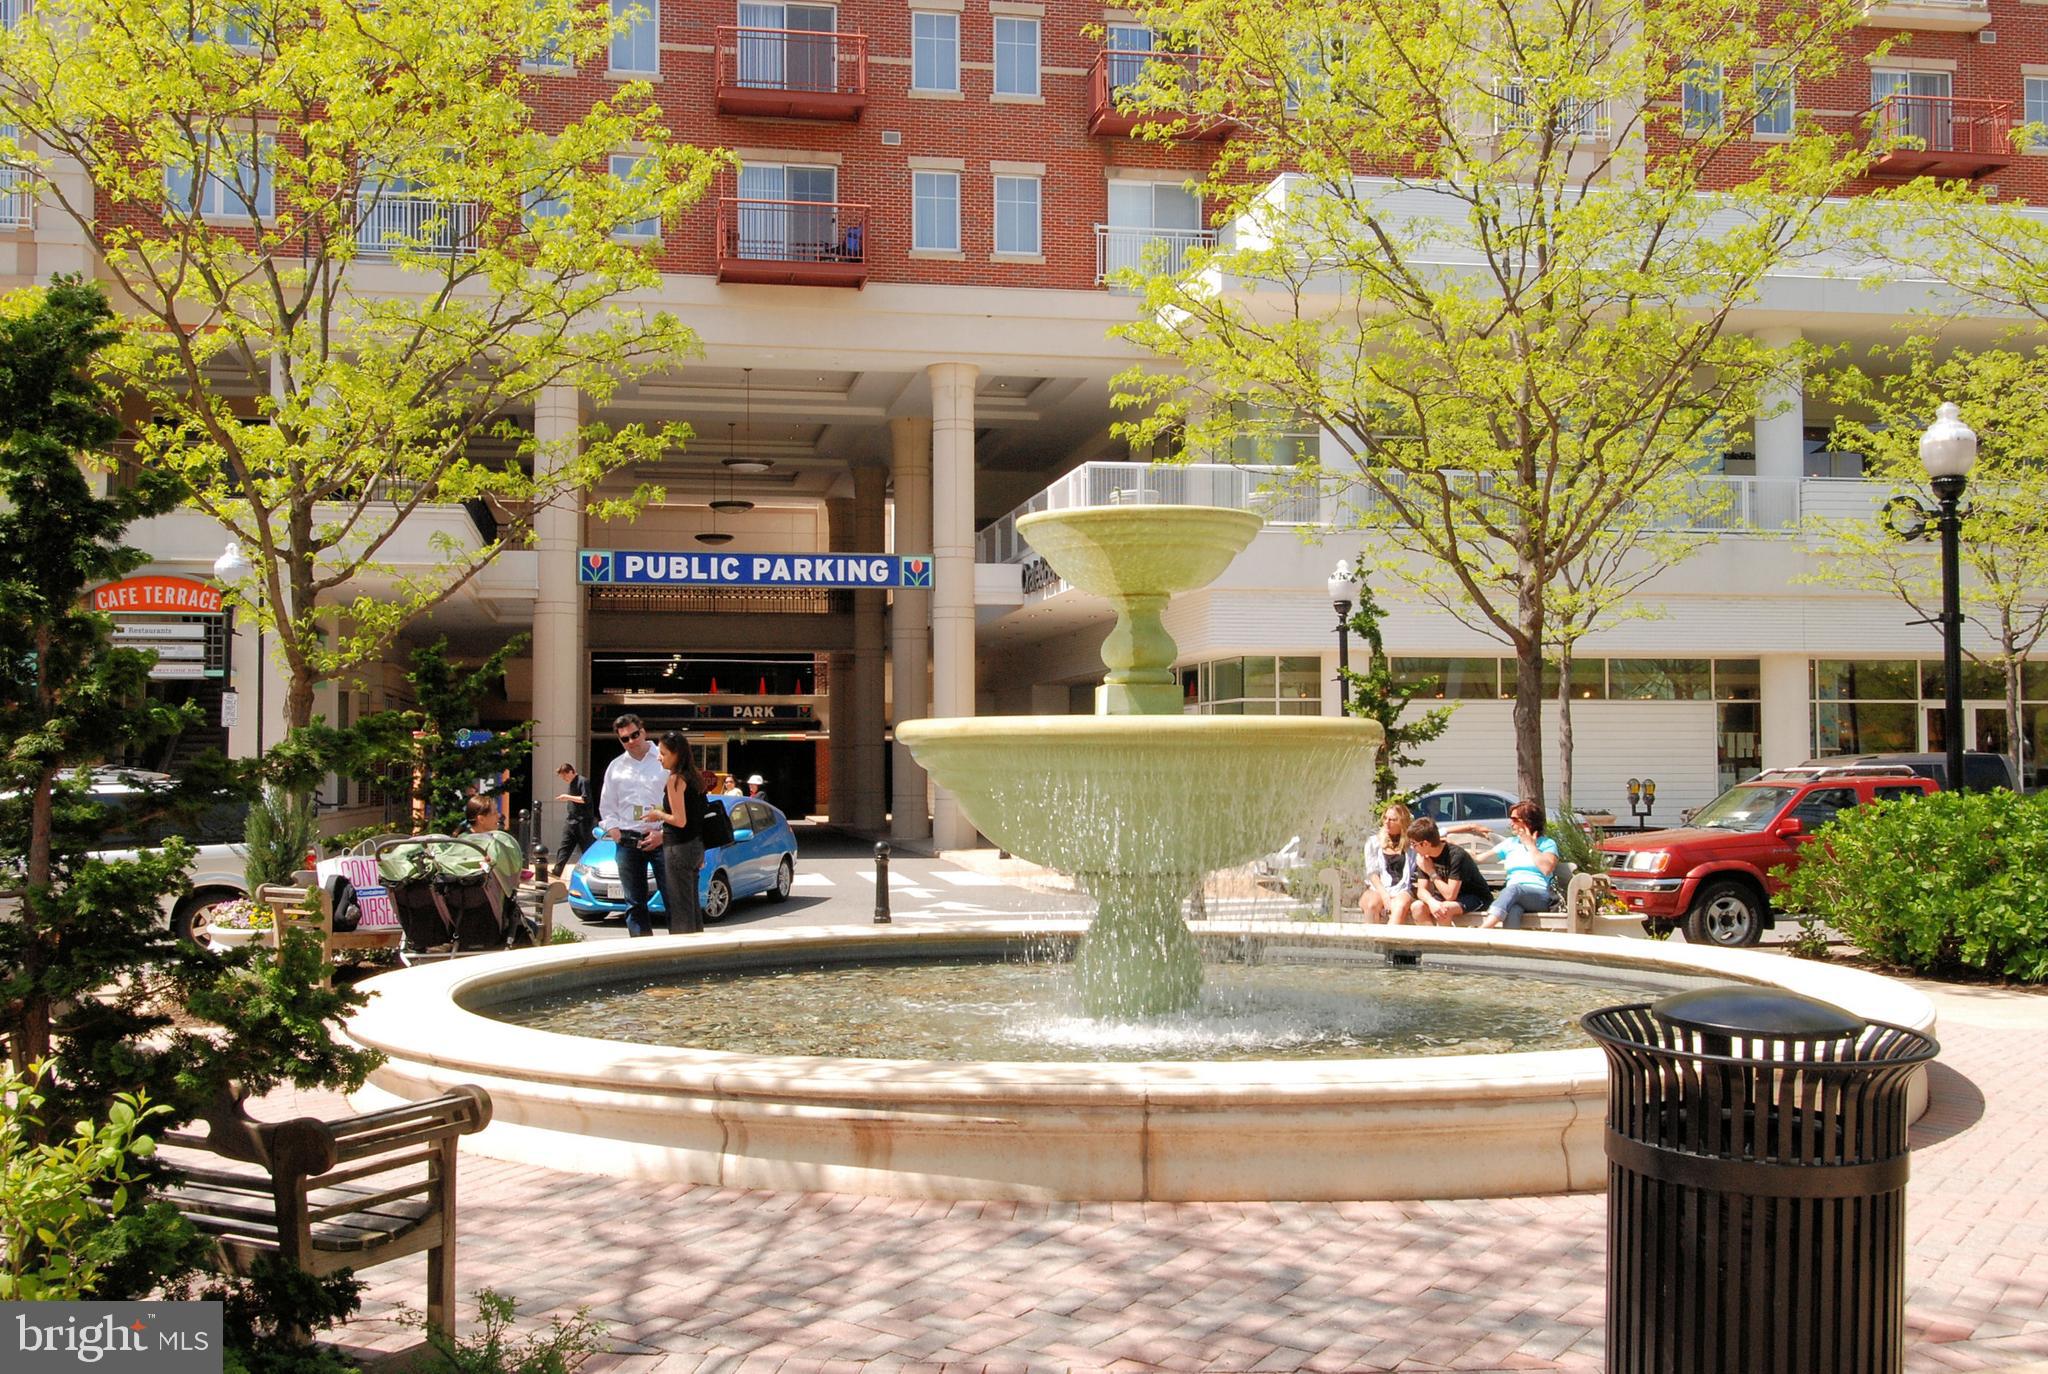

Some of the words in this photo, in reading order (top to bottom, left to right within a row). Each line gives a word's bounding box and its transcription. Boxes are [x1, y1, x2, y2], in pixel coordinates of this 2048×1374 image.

[625, 555, 740, 580] PUBLIC
[753, 556, 889, 582] PARKING
[97, 587, 139, 609] CAFE
[143, 586, 220, 611] TERRACE
[128, 627, 173, 635] Restaurants
[733, 706, 775, 718] PARK
